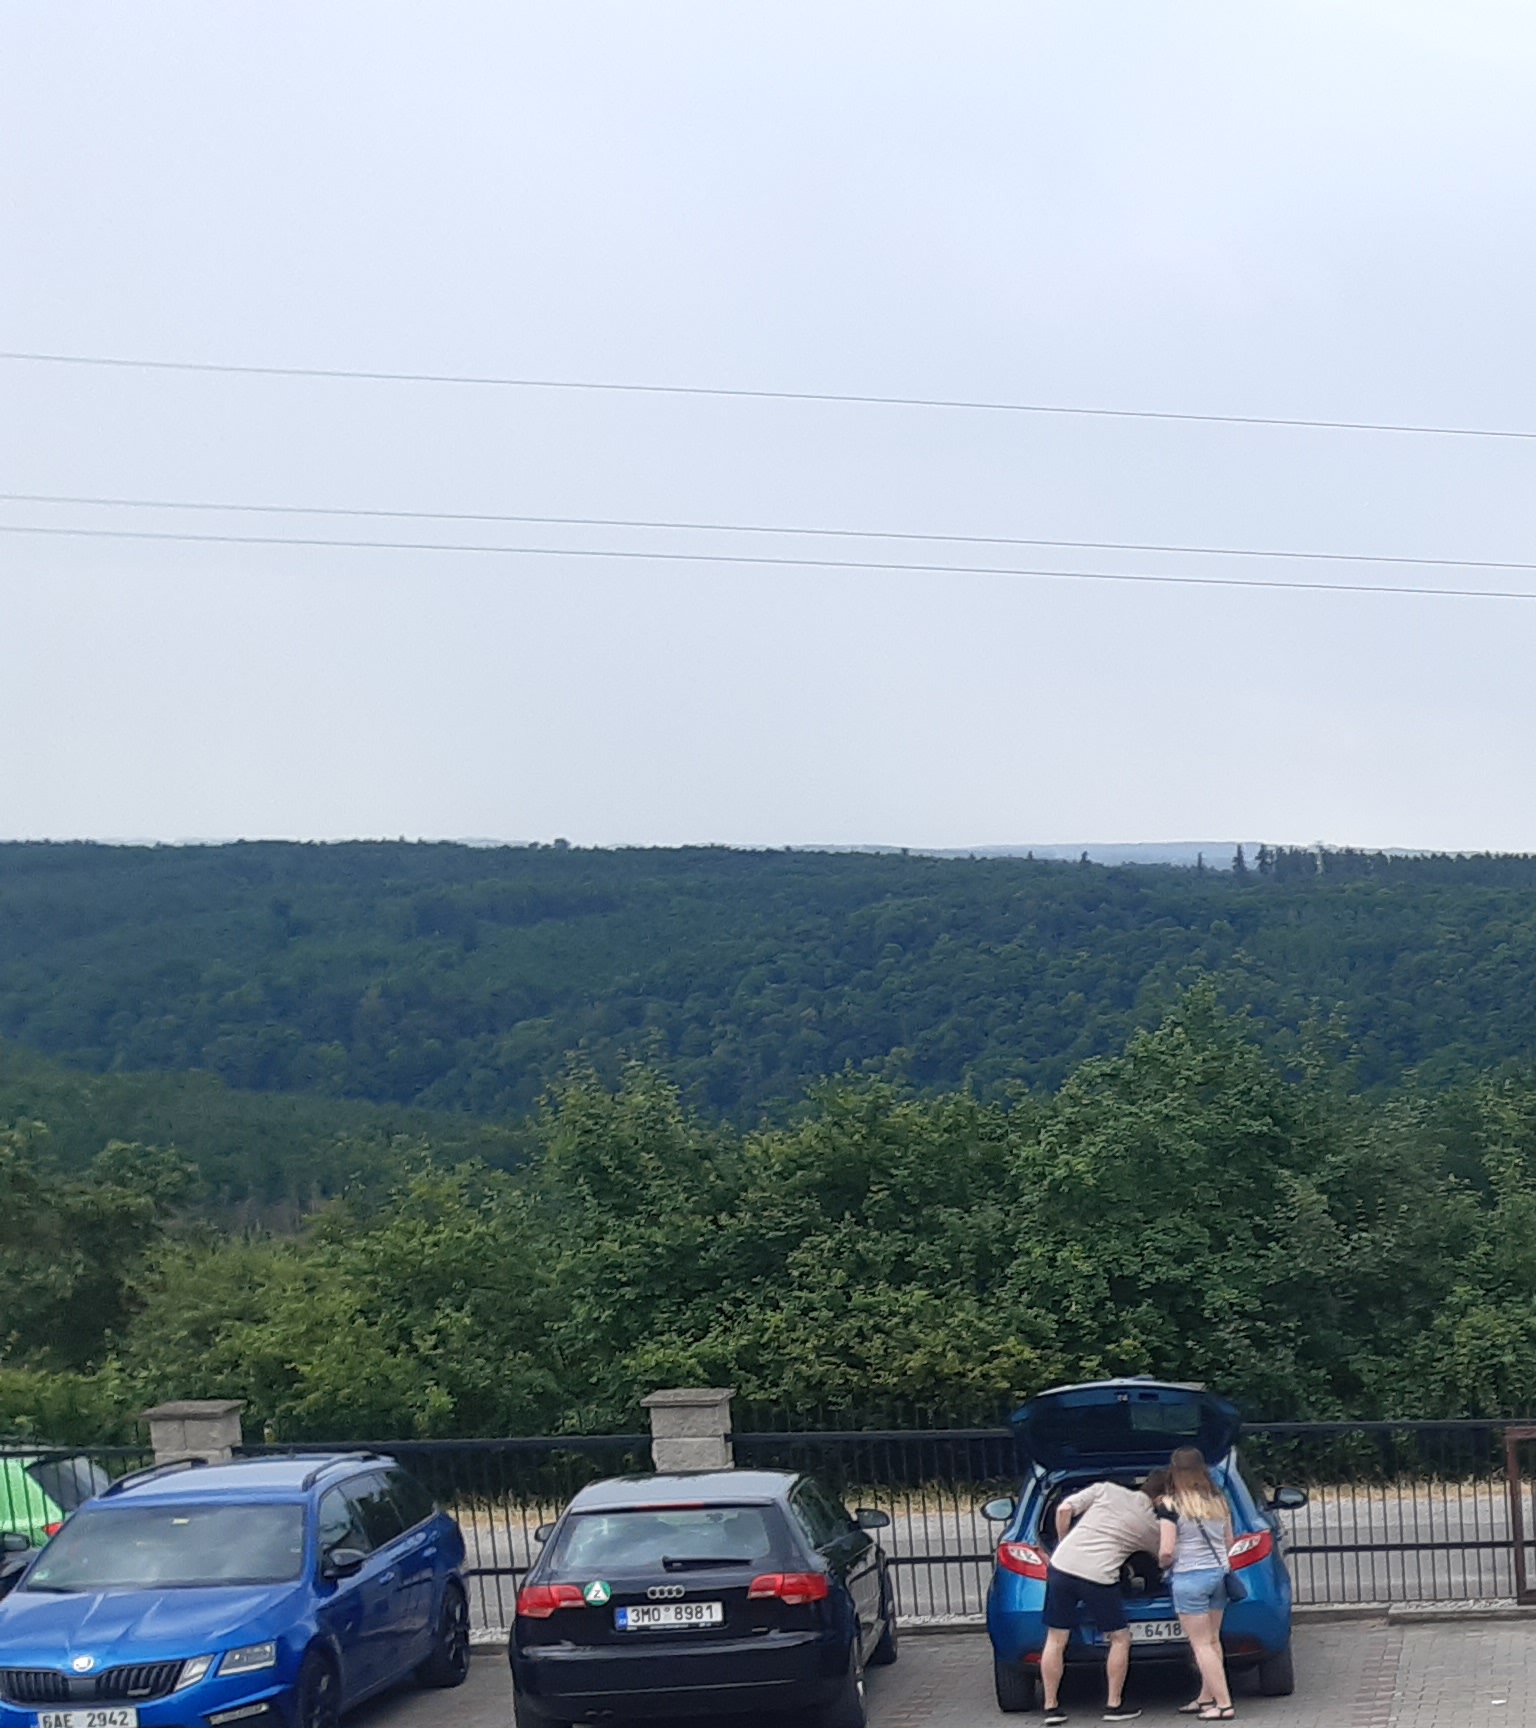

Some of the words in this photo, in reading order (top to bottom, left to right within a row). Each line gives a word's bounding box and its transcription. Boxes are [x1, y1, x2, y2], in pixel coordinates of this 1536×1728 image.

[674, 1604, 713, 1621] 8981
[1144, 1623, 1182, 1637] 6418
[86, 1711, 129, 1728] 2942
